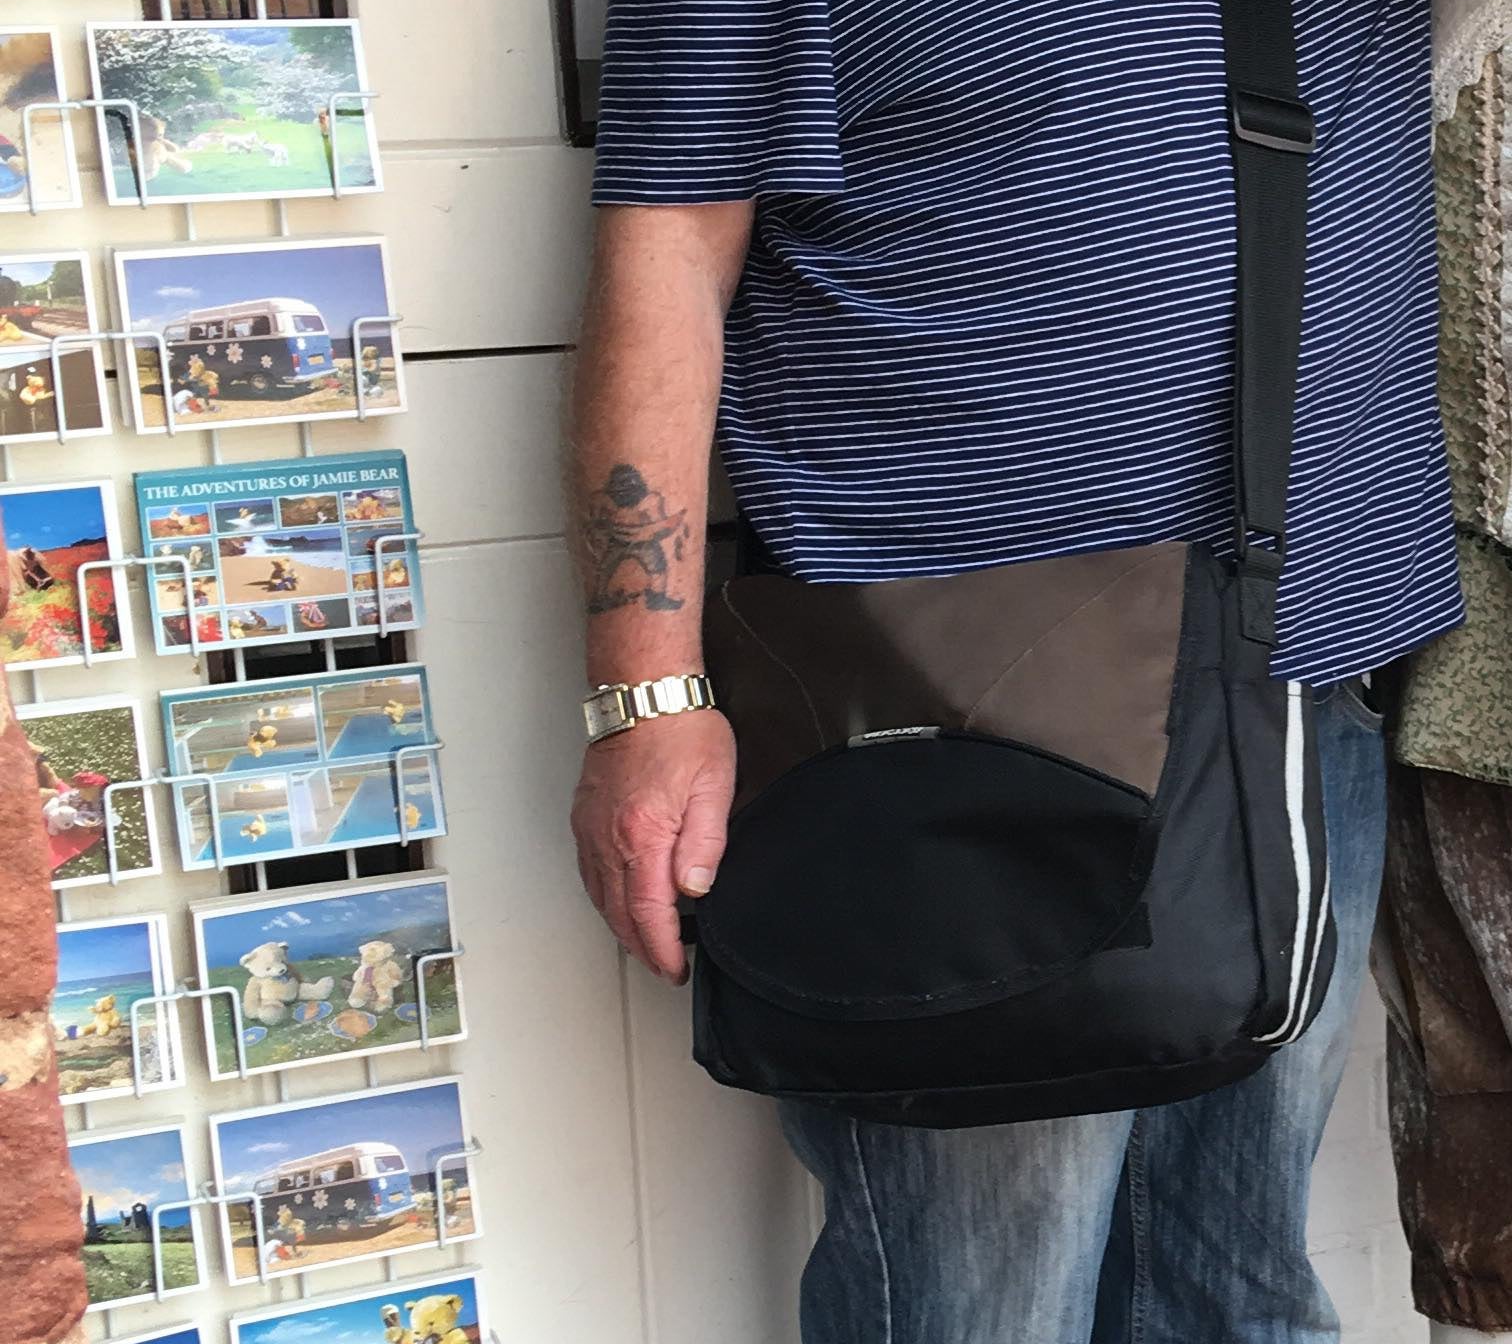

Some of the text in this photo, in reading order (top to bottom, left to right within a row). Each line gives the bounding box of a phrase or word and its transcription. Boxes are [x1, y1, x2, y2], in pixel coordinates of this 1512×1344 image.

[143, 467, 399, 499] THE ADVENTURES OF JAMIE BEAR
